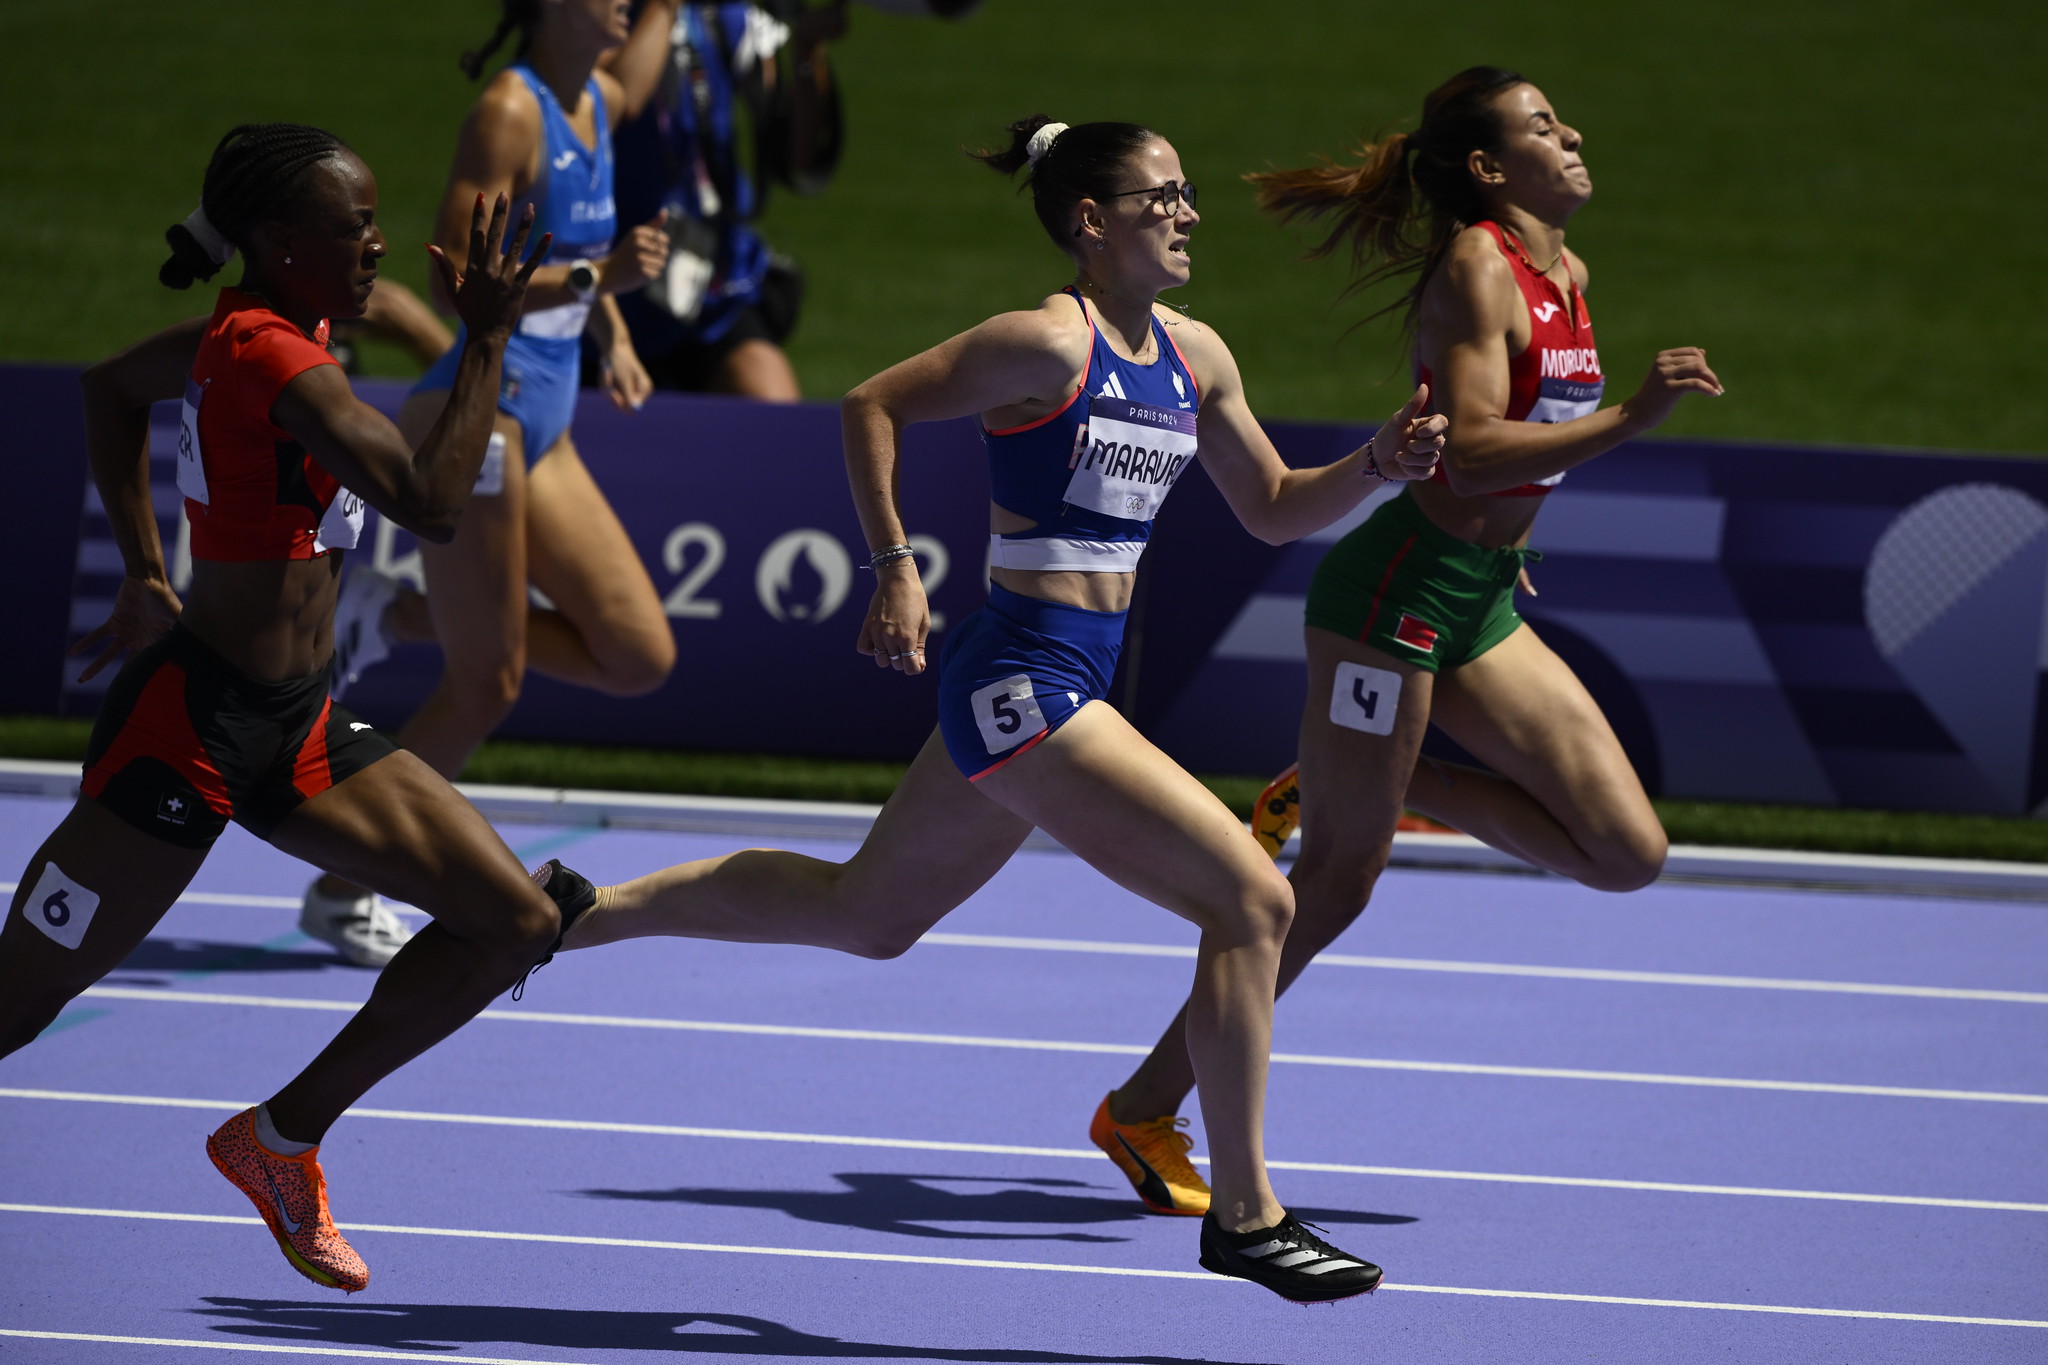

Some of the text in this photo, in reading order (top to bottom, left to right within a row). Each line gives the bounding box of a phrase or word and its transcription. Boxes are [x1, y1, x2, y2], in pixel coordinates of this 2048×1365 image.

[1129, 407, 1178, 426] PARIS 2024
[991, 692, 1022, 734] 5
[1352, 677, 1379, 720] 4
[43, 888, 70, 927] 6
